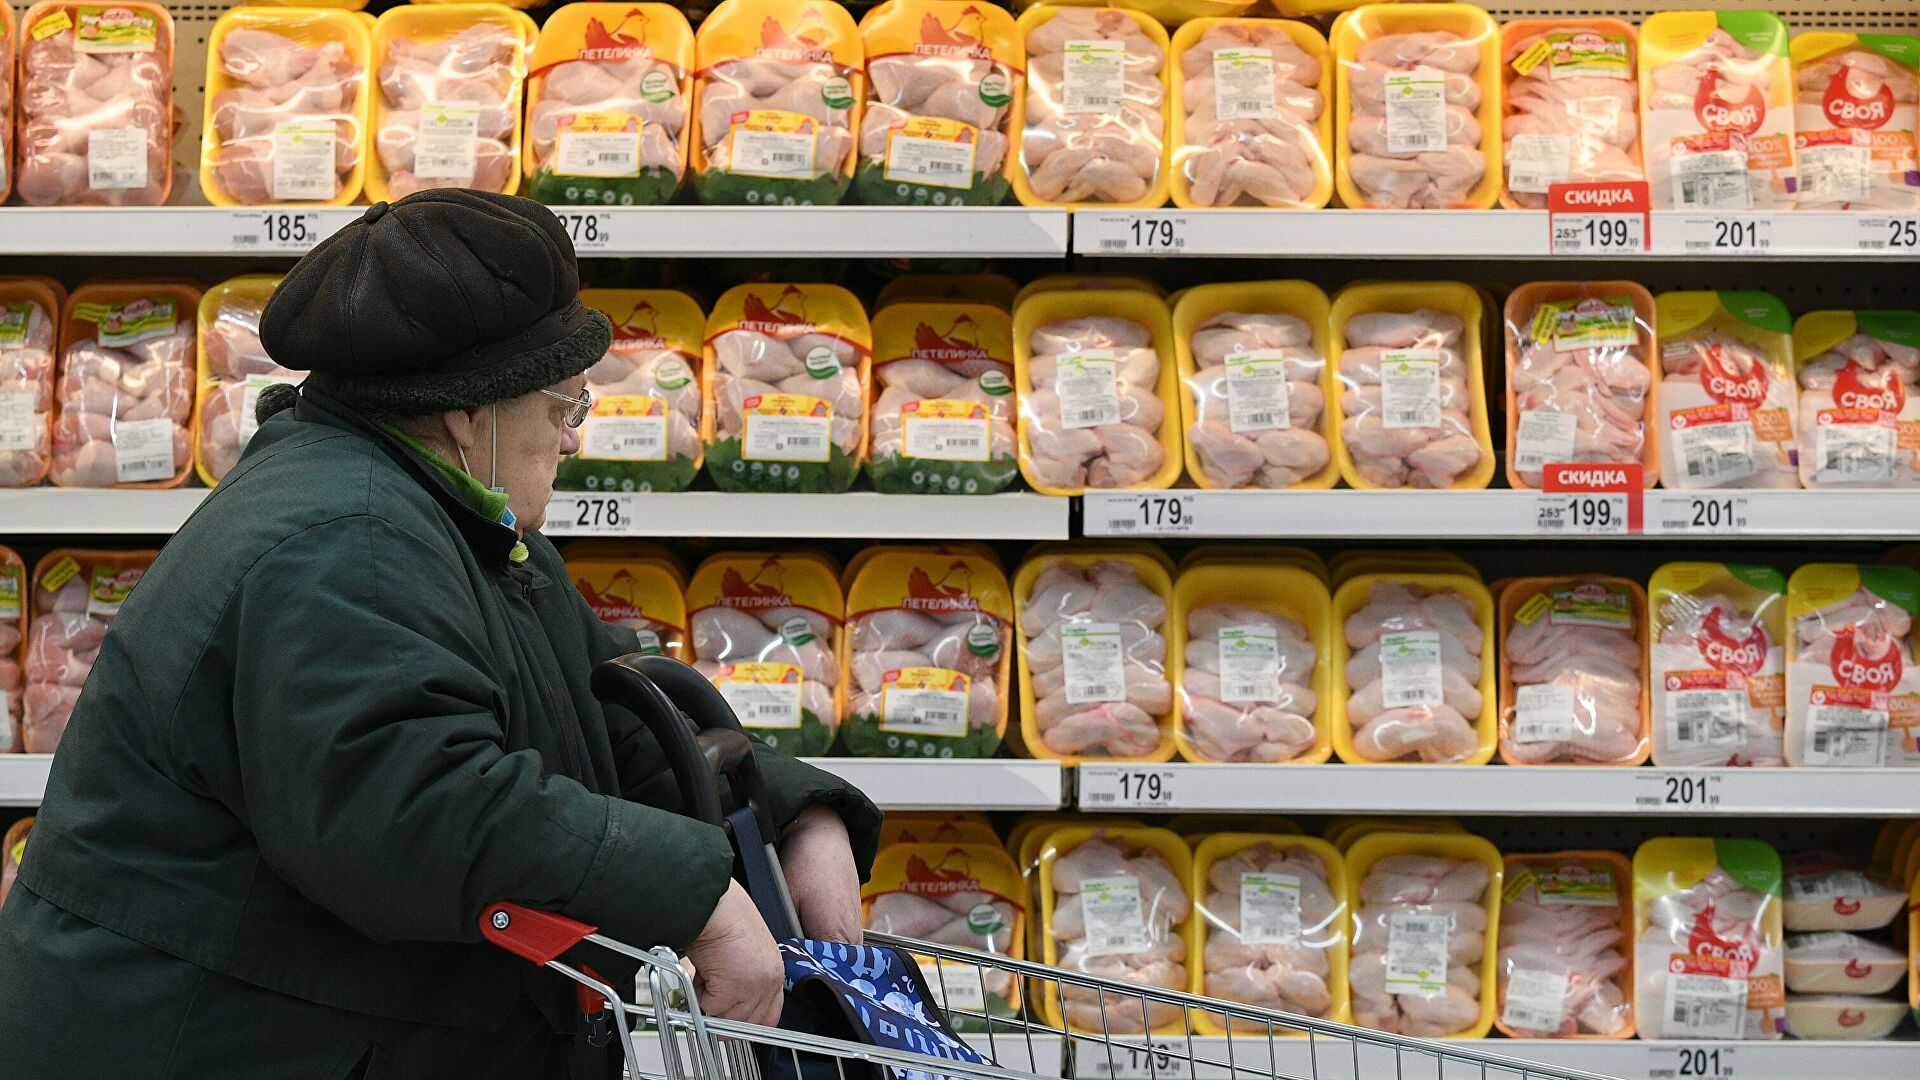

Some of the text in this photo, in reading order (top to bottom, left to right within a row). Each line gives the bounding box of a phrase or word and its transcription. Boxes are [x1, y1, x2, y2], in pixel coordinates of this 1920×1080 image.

[578, 47, 653, 60] ПЕТЕЛИНКА
[1702, 103, 1758, 125] СВОЯ
[1829, 99, 1884, 120] СВОЯ
[1564, 188, 1634, 207] СКИДКА
[264, 214, 306, 241] 185
[1131, 219, 1173, 246] 179
[1585, 219, 1627, 246] 199
[1715, 221, 1756, 247] 201
[1889, 220, 1920, 247] 25
[739, 320, 816, 334] ПЕТЕЛИНКА
[911, 349, 988, 359] ПЕТЕЛИНКА
[1710, 376, 1762, 399] СВОЯ
[1840, 391, 1897, 409] СВОЯ
[1558, 469, 1628, 488] СКИДКА
[577, 499, 619, 526] 278
[1140, 498, 1181, 524] 179
[1569, 499, 1610, 525] 199
[1692, 499, 1732, 526] 201
[715, 596, 792, 607] ПЕТЕЛИНКА
[903, 597, 979, 611] ПЕТЕЛИНКА
[1706, 642, 1760, 663] СВОЯ
[1837, 659, 1895, 682] СВОЯ
[1120, 773, 1161, 800] 179
[1666, 777, 1706, 803] 201
[902, 880, 980, 892] ПЕТЕЛИНКА
[1680, 1049, 1719, 1075] 201
